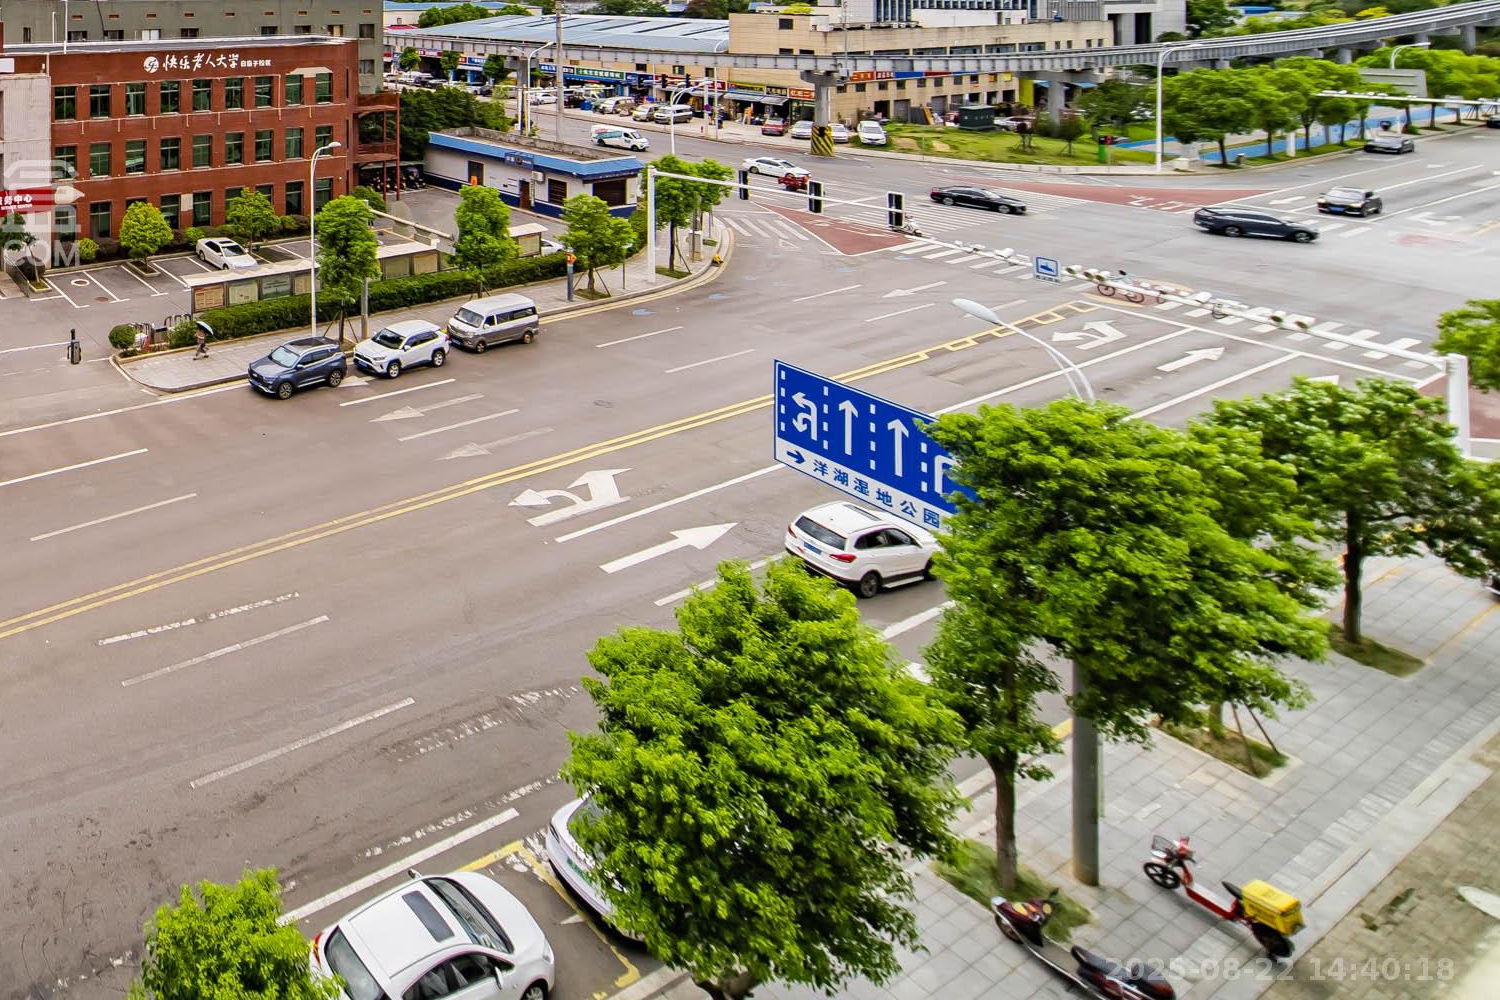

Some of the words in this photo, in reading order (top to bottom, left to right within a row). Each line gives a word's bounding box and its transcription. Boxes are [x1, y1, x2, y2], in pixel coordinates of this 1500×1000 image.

[163, 53, 240, 72] 快乐老人大学
[813, 459, 940, 528] 洋湖湿地公园
